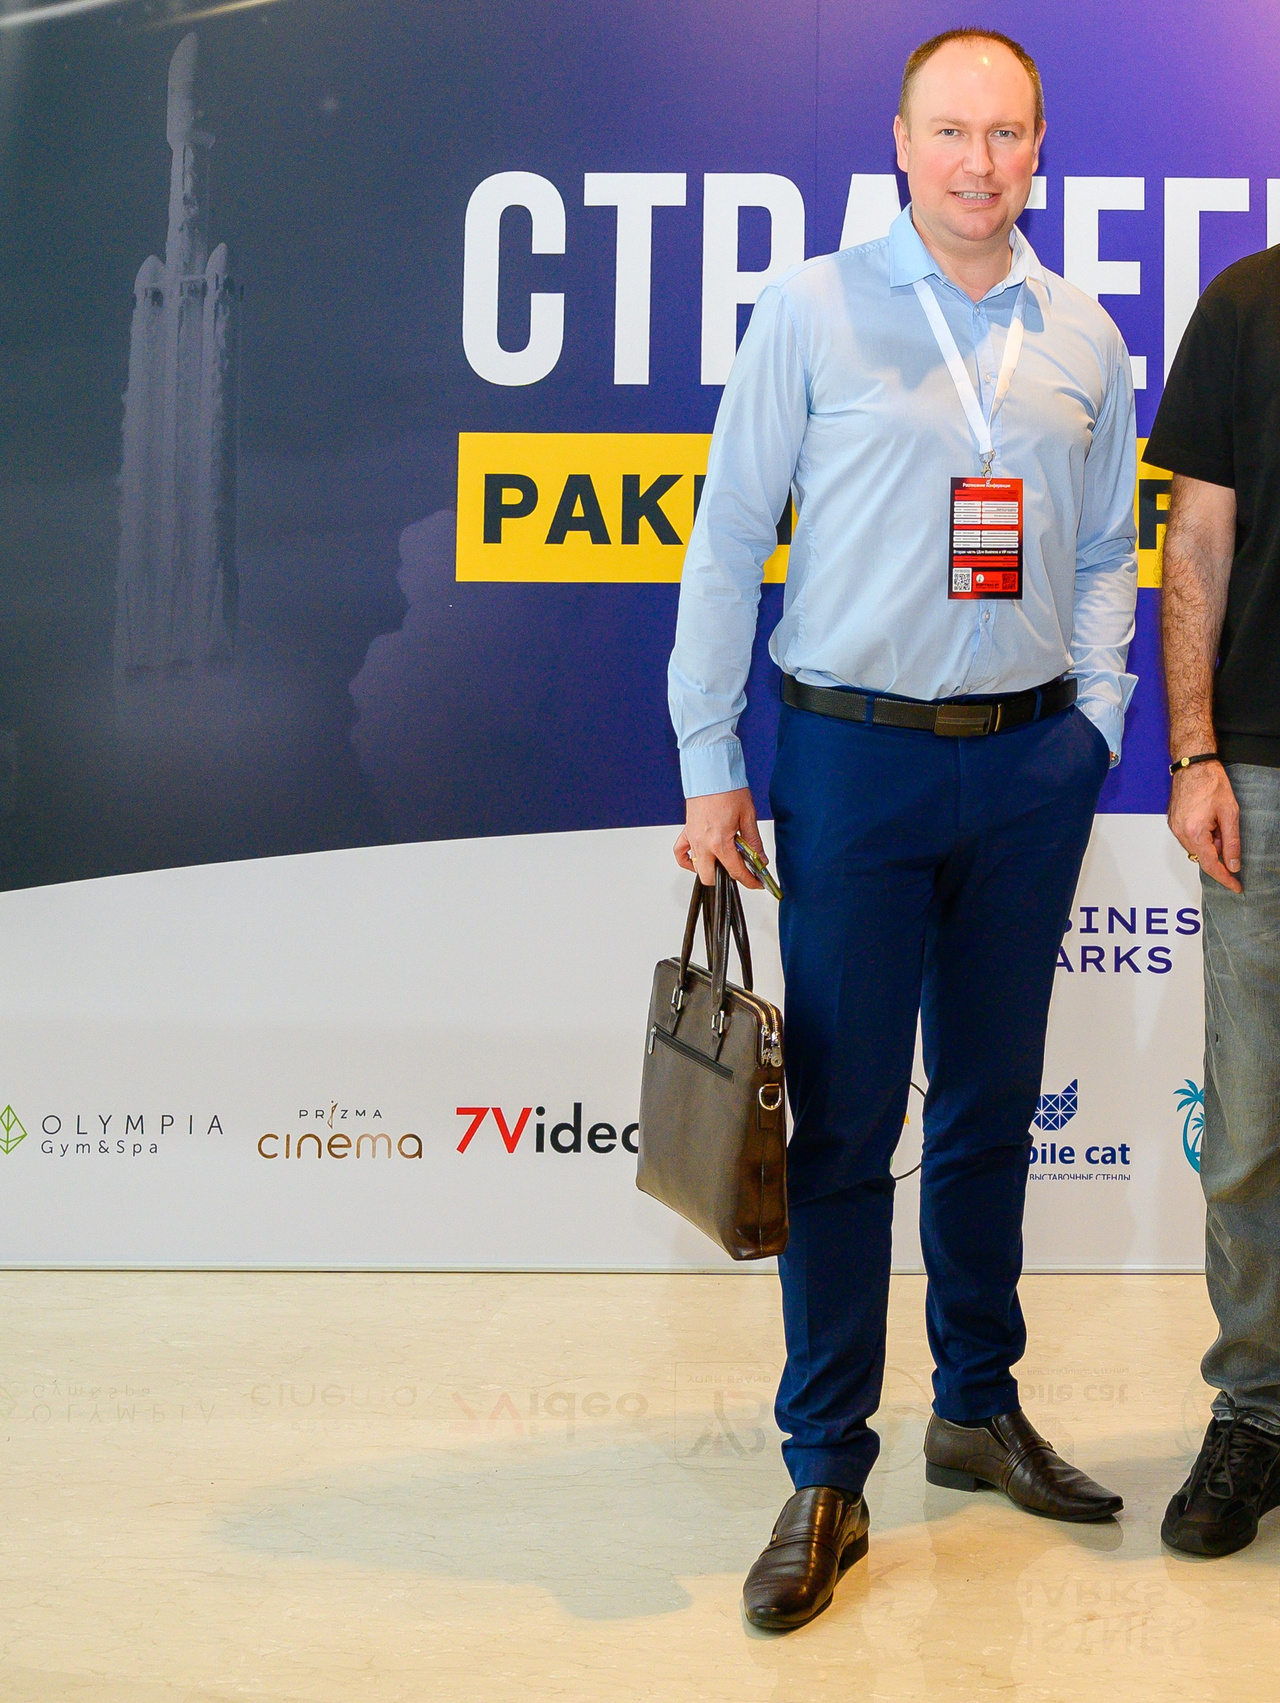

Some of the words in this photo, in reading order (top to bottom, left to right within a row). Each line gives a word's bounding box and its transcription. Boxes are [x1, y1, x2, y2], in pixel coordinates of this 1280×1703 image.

[483, 473, 706, 545] РАК
[1064, 907, 1201, 935] INES
[42, 1115, 224, 1135] OLYMPIA
[41, 1140, 158, 1157] Gym&Spa
[257, 1133, 423, 1160] cinema
[1085, 1143, 1131, 1165] cat
